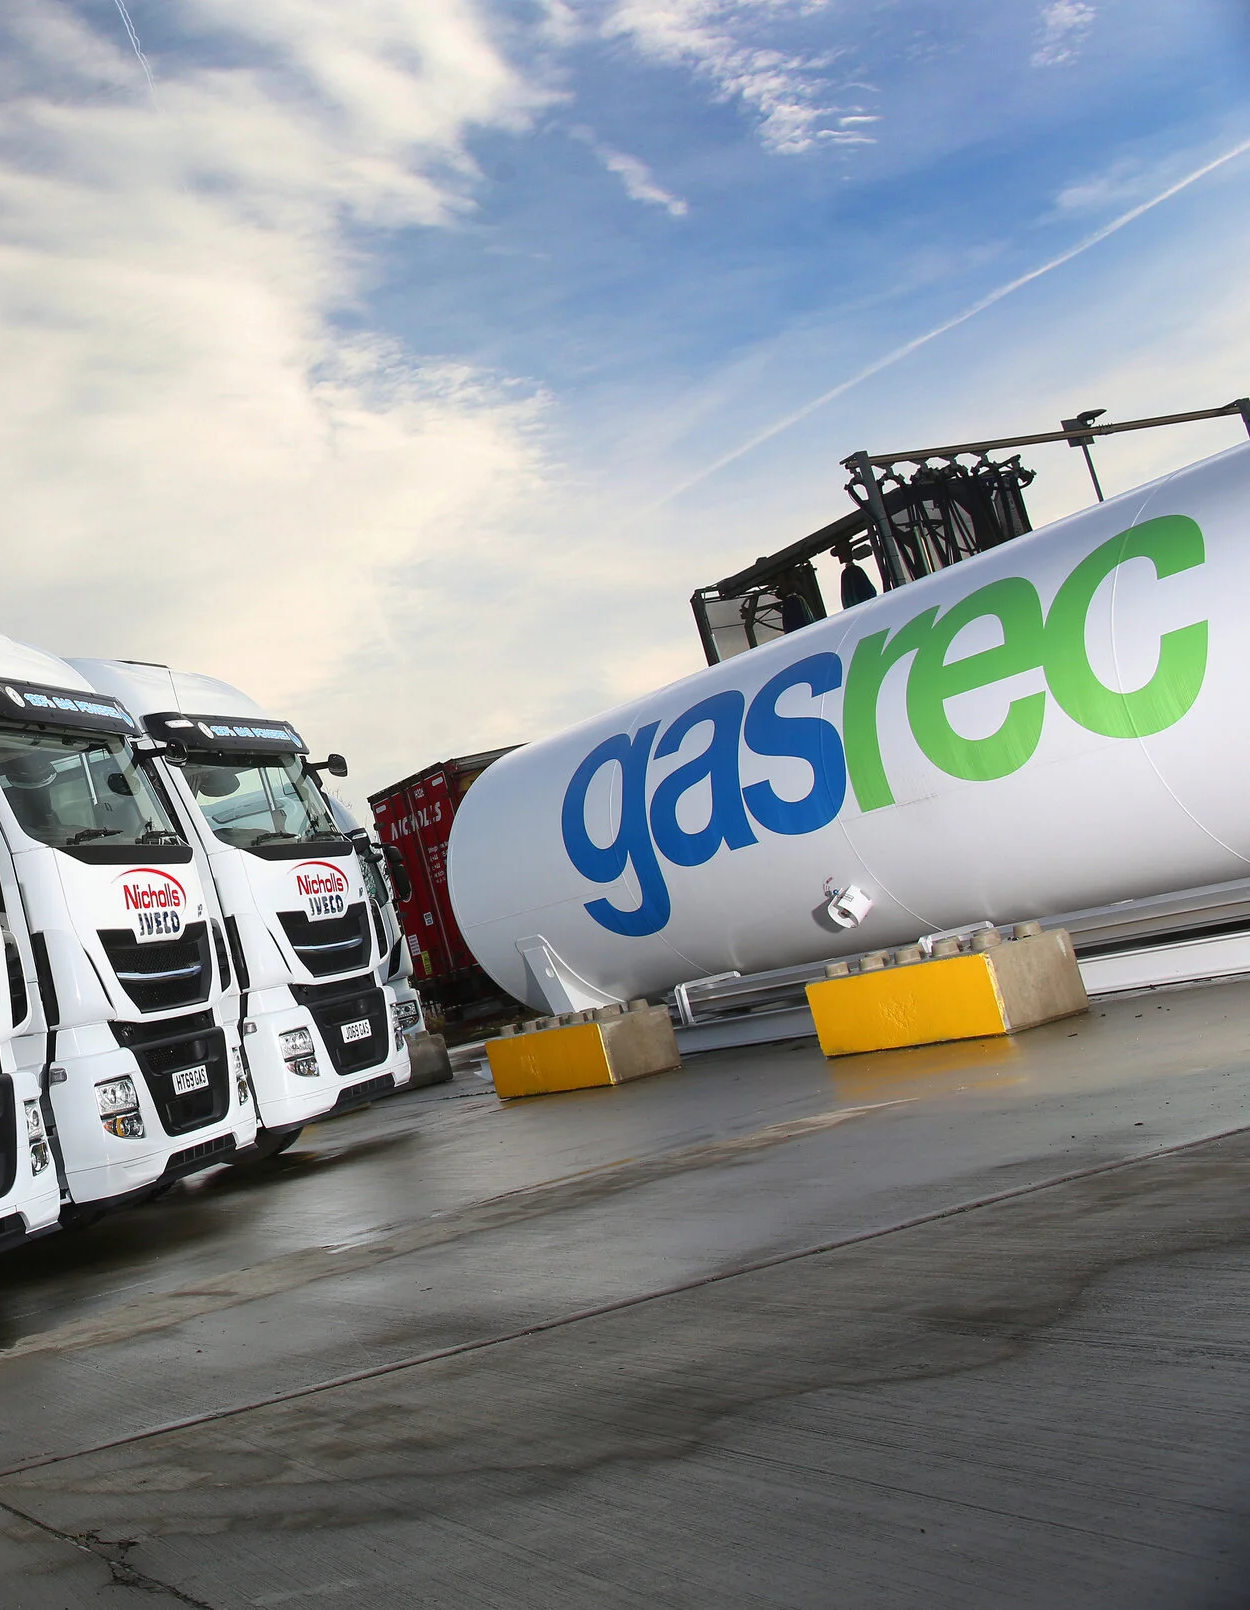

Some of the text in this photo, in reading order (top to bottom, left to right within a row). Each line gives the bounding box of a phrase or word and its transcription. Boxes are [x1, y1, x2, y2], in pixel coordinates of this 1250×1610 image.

[561, 514, 1208, 937] gasrec
[123, 883, 180, 910] Nicholls
[296, 873, 343, 896] Nicholls
[309, 894, 344, 916] IVECO
[138, 910, 180, 936] IVECO
[176, 1068, 206, 1091] HT69 GAS
